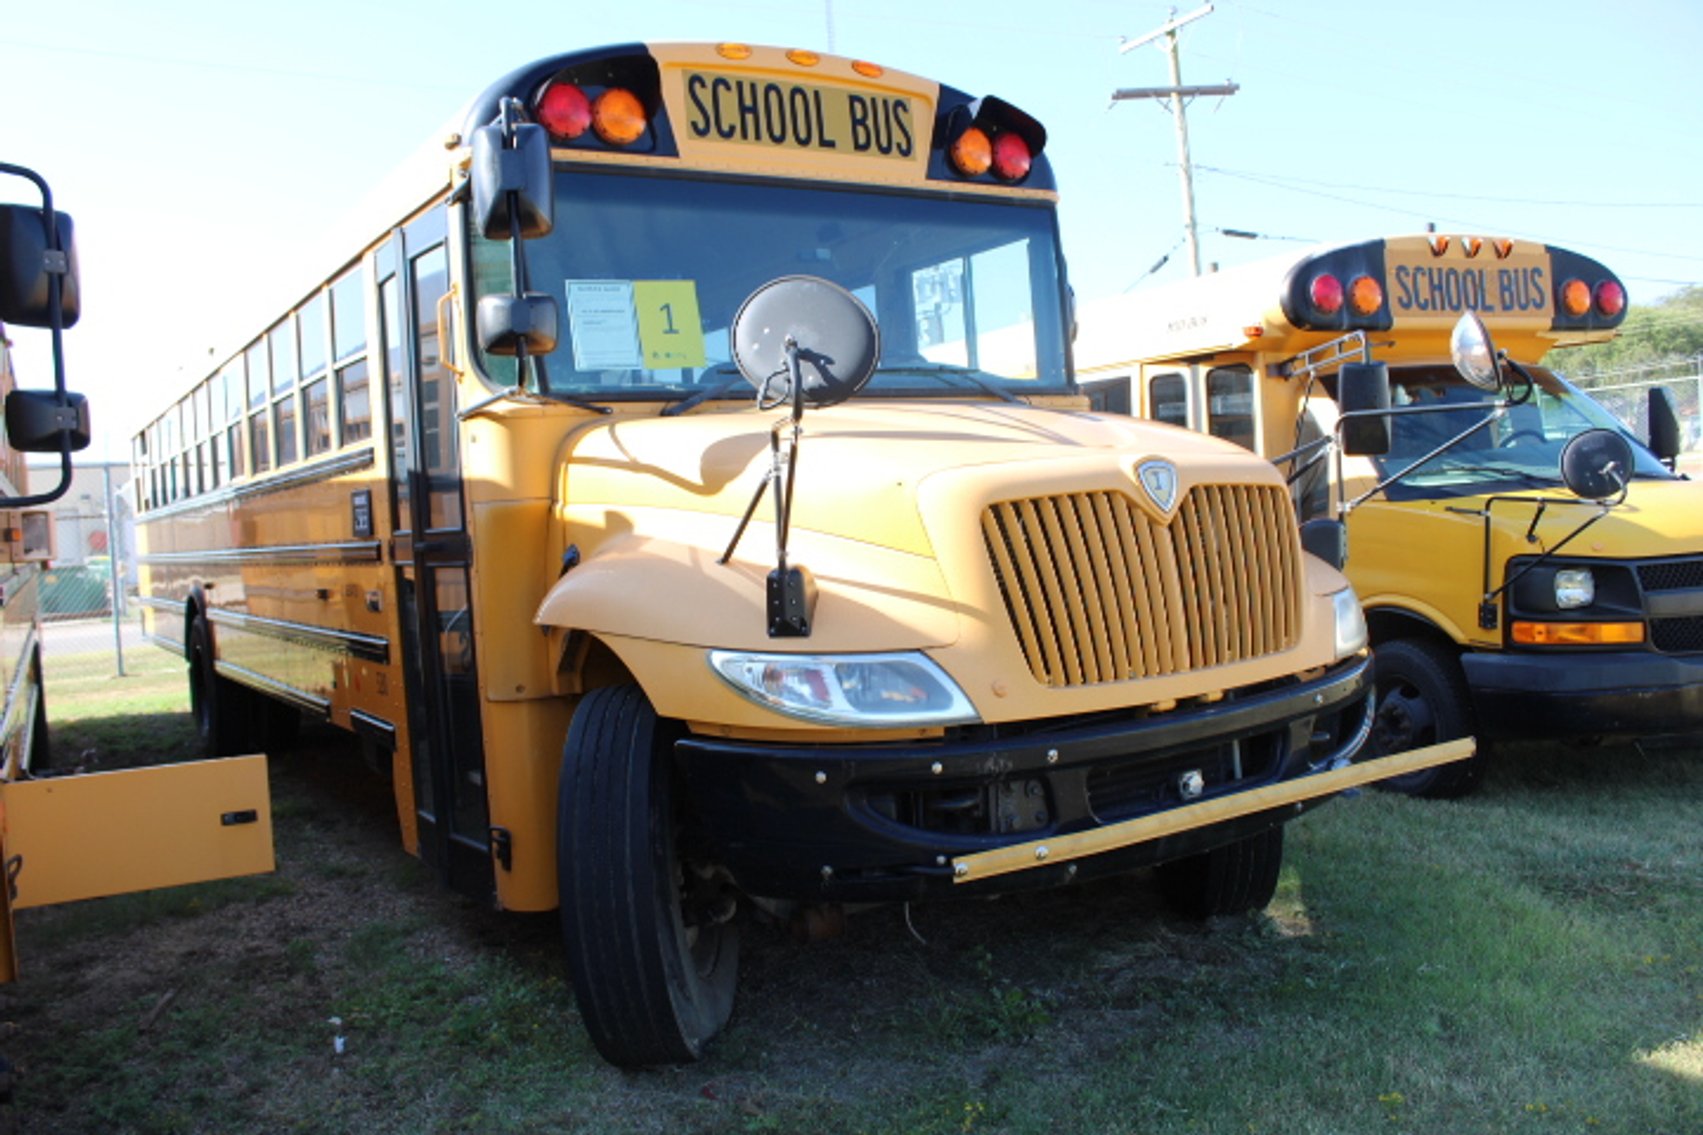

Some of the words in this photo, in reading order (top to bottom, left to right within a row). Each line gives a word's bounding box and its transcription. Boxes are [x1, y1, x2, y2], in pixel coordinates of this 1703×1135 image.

[688, 73, 836, 148] SCHOOL
[848, 94, 913, 158] BUS
[1395, 265, 1495, 312] SCHOOL
[1498, 267, 1546, 311] BUS
[660, 303, 680, 335] 1
